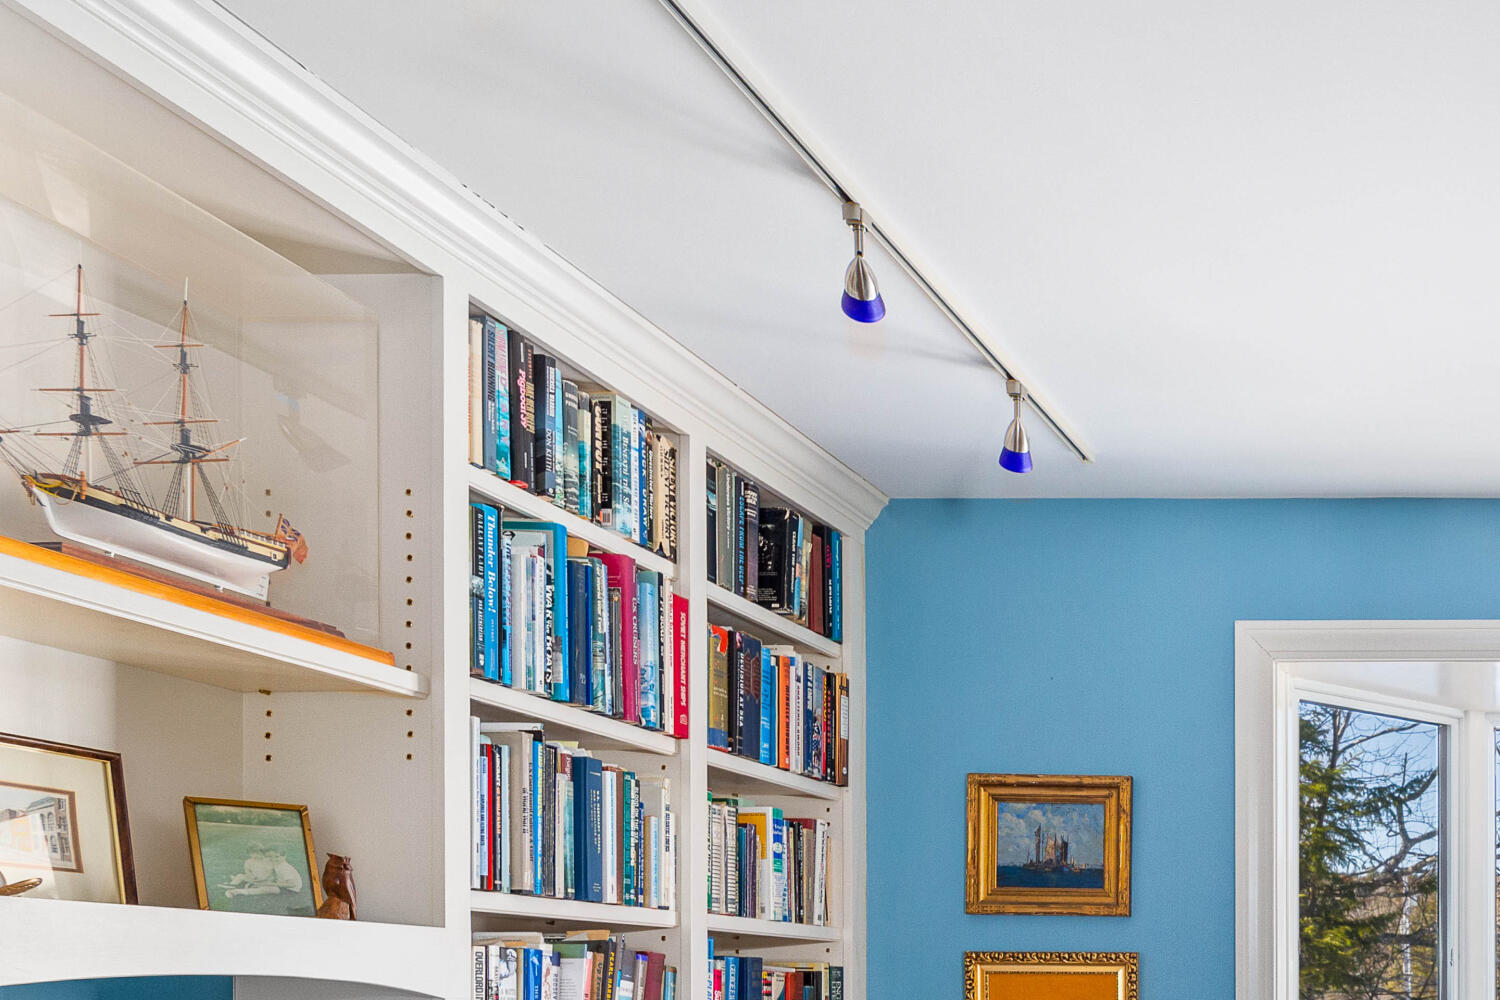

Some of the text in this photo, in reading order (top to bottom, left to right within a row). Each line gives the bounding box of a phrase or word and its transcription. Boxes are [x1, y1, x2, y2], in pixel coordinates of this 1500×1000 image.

[487, 515, 496, 613] Thunder Below!
[475, 951, 484, 994] OVERLORD
[608, 951, 616, 977] PEARL
